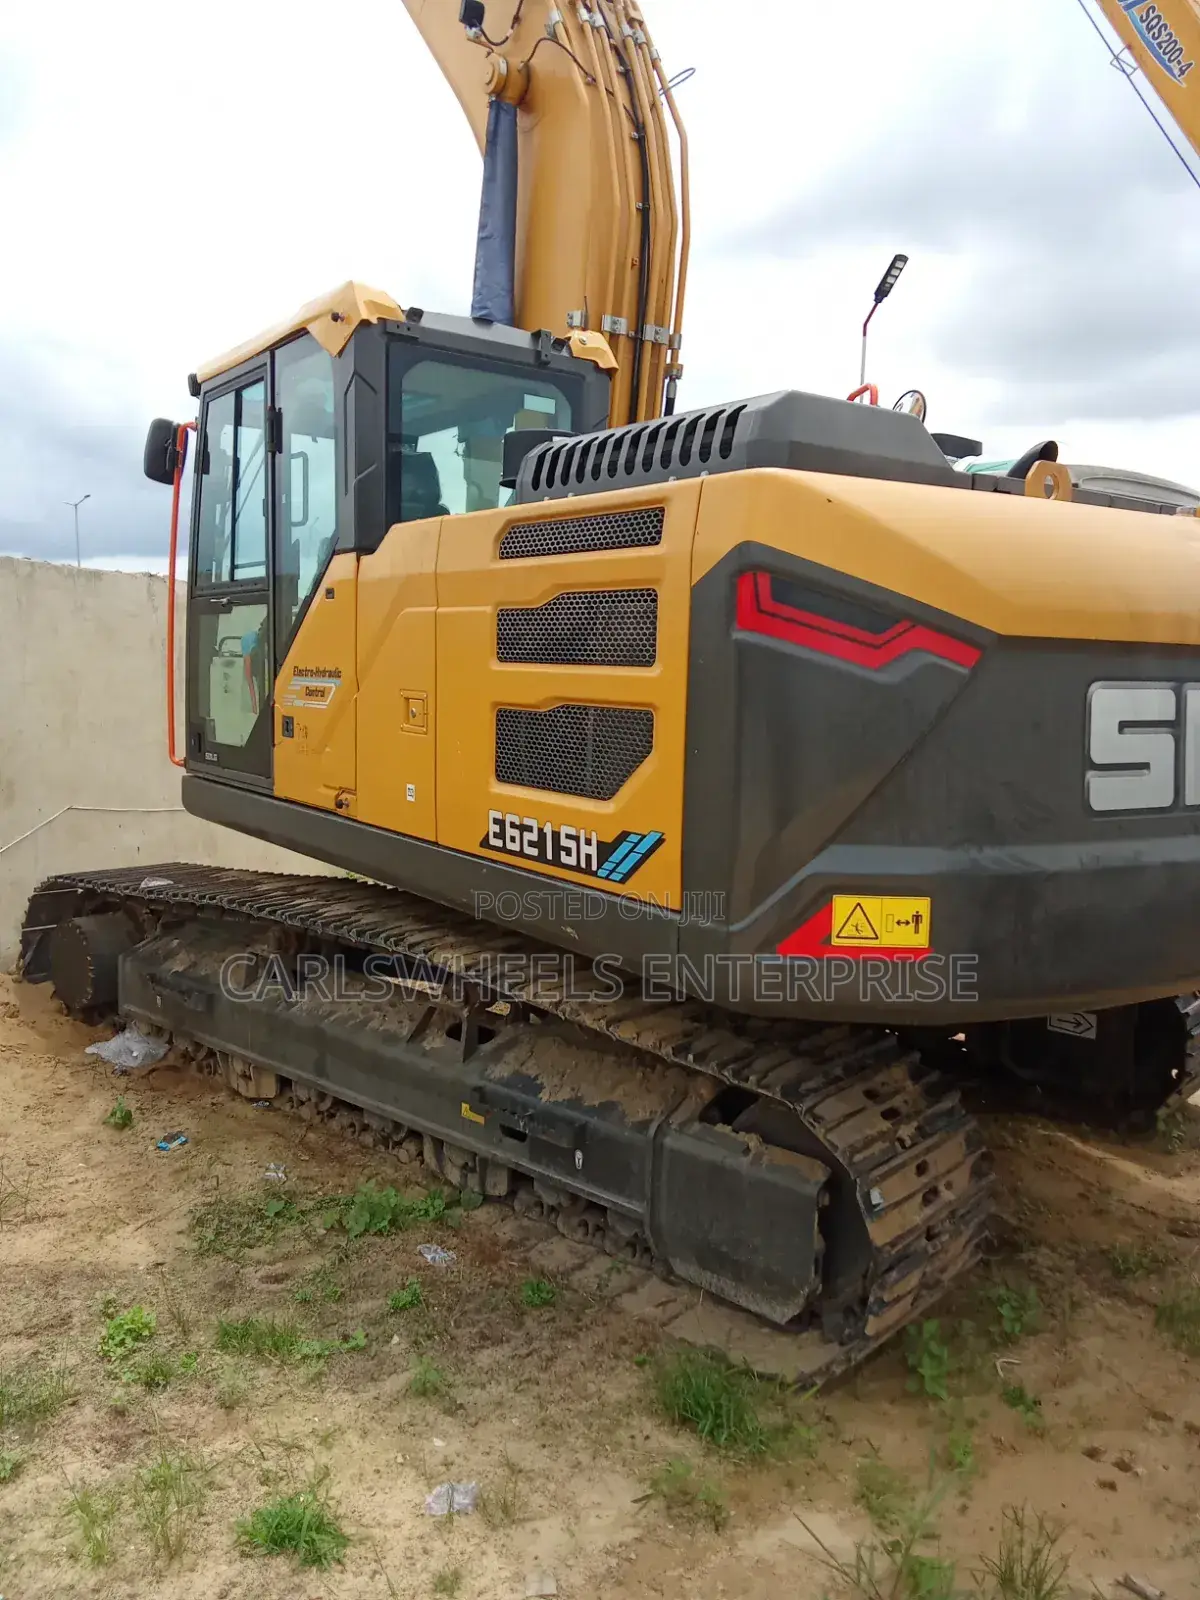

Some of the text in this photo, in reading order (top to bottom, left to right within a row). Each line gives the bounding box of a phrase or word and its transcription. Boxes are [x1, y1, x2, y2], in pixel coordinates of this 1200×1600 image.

[1139, 4, 1194, 78] SQS200-4
[293, 665, 342, 679] Electro-Hydraulic
[305, 686, 326, 698] Control
[1086, 682, 1200, 812] S
[488, 808, 598, 872] E6215H
